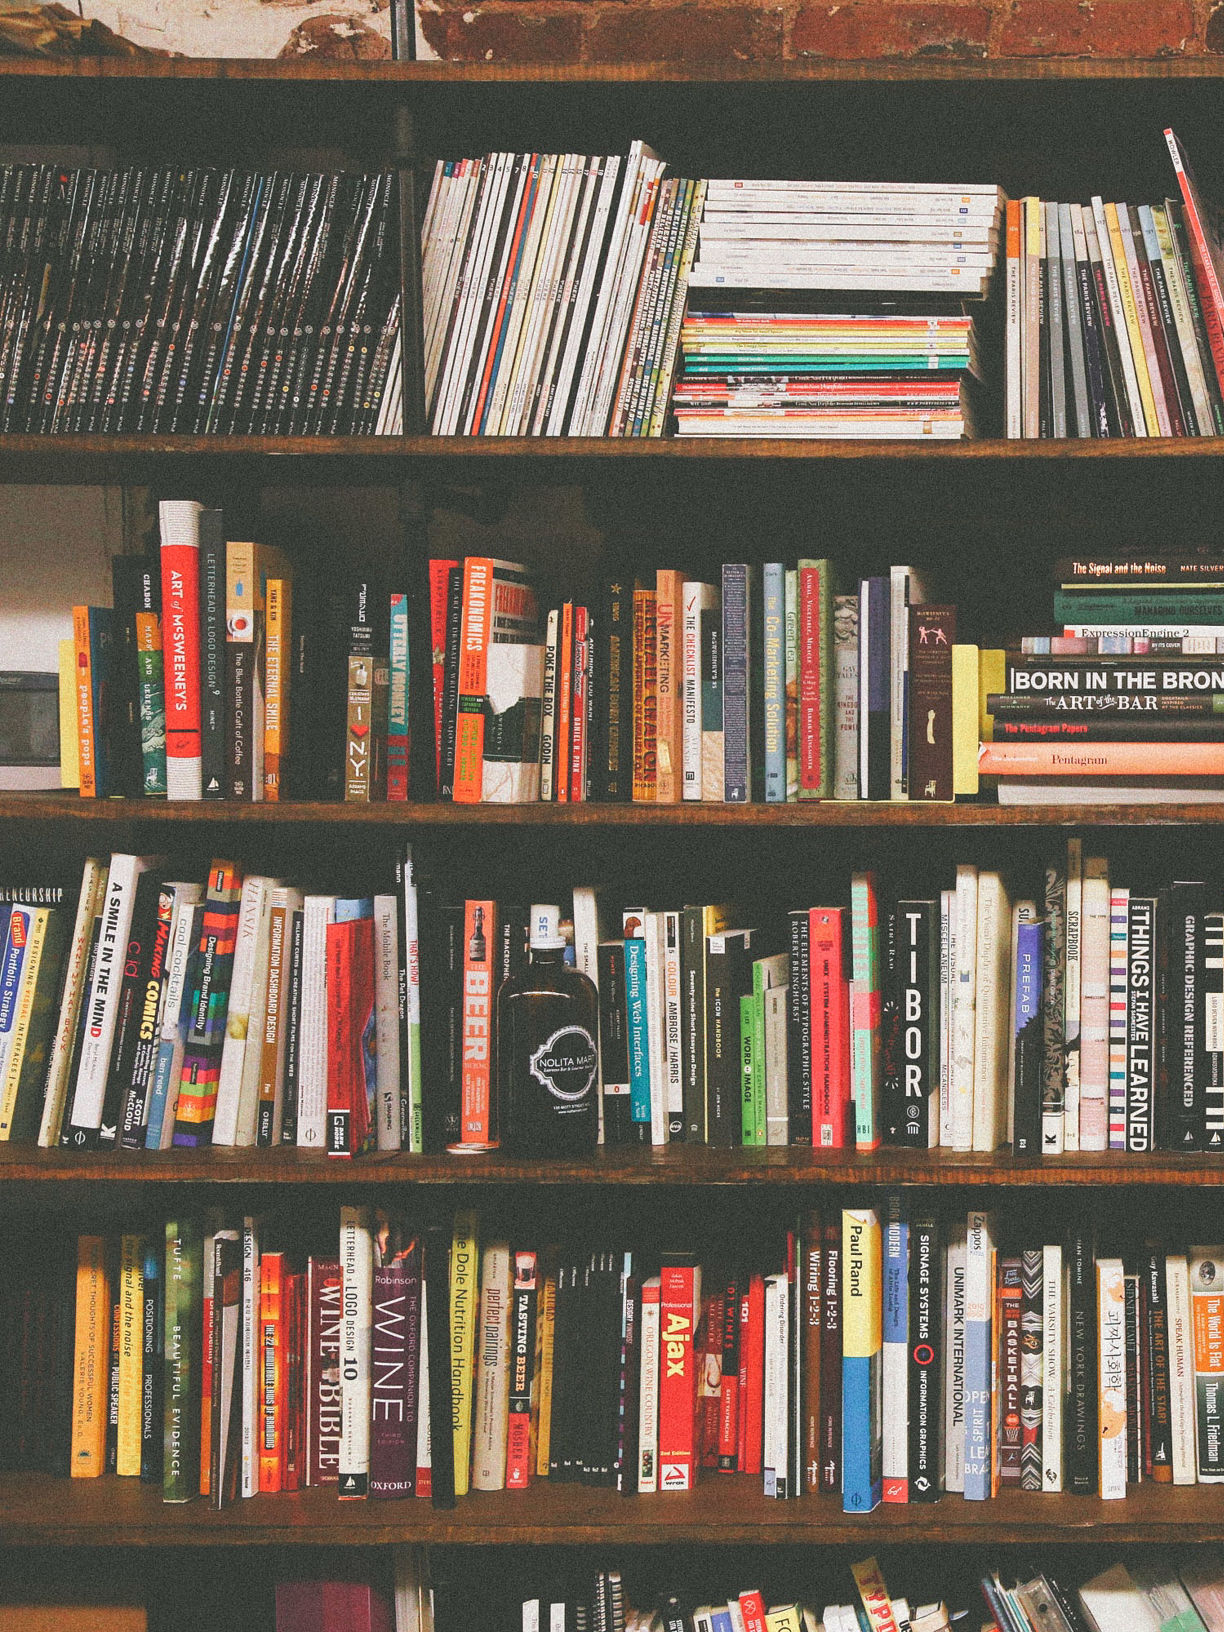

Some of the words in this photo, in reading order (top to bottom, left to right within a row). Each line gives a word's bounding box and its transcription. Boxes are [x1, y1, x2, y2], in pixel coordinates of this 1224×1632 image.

[328, 176, 338, 208] MONOCLE
[383, 174, 392, 207] MONOCLE
[668, 210, 682, 253] BELIEVER
[1158, 283, 1166, 299] PARIS
[1162, 301, 1171, 324] REVIEW
[171, 570, 182, 598] ART
[207, 554, 216, 613] LETTERHEAD
[1073, 563, 1086, 574] The
[1089, 563, 1112, 575] Signal
[1115, 564, 1128, 574] and
[1130, 564, 1142, 573] the
[1144, 564, 1166, 573] Noise
[172, 601, 183, 610] of
[467, 566, 487, 651] FREAKONOMICS
[768, 596, 777, 610] The
[208, 626, 216, 650] LOGO
[686, 616, 695, 630] THE
[1082, 629, 1180, 638] ExpressionEngine
[1183, 629, 1189, 638] 2
[235, 652, 243, 665] The
[267, 635, 279, 653] THE
[393, 614, 406, 669] UTTERLY
[545, 646, 555, 671] POKE
[686, 634, 695, 676] CHECKLIST
[765, 616, 780, 699] Co-Marketing
[208, 653, 216, 687] DESIGN
[235, 668, 243, 683] Blue
[267, 657, 279, 698] ETERNAL
[545, 675, 554, 693] THE
[1015, 672, 1078, 689] BORN
[1085, 672, 1106, 689] IN
[1113, 672, 1156, 689] THE
[80, 685, 91, 734] people's
[235, 686, 243, 707] Bottle
[392, 672, 405, 724] MONKEY
[544, 697, 553, 717] BOX
[686, 680, 695, 723] MANIFESTO
[1044, 697, 1055, 706] The
[1056, 696, 1094, 710] ART
[1117, 695, 1158, 710] BAR
[235, 710, 243, 728] Craft
[266, 703, 278, 730] SMILE
[767, 704, 780, 752] Solution
[1005, 724, 1017, 733] The
[1021, 723, 1059, 734] Pentagram
[1062, 723, 1088, 734] Papers
[82, 739, 92, 766] pops
[234, 740, 243, 765] Coffee
[542, 735, 552, 764] GODIN
[1052, 754, 1107, 765] Pentagram
[113, 883, 122, 892] A
[13, 917, 23, 944] Brand
[105, 897, 120, 942] SMILE
[382, 914, 391, 927] The
[1068, 911, 1078, 961] SCRAPBOOK
[103, 947, 113, 962] IN
[151, 921, 169, 978] MAKING
[203, 937, 216, 974] Designing
[269, 916, 282, 966] INFORMATION
[382, 930, 391, 957] Mobile
[791, 921, 799, 958] ROBERT
[1131, 912, 1149, 987] THINGS
[1185, 915, 1194, 972] GRAPHIC
[6, 948, 20, 988] Portfolio
[97, 968, 110, 994] THE
[383, 960, 391, 980] Book
[629, 946, 640, 997] Designing
[668, 961, 676, 996] COLOUR
[1021, 954, 1031, 1013] PREFAB
[201, 976, 211, 998] Brand
[267, 969, 279, 1014] DASHBOARD
[792, 961, 800, 1022] BRINGHURST
[801, 994, 808, 1007] OF
[1184, 975, 1194, 1021] DESIGN
[0, 990, 15, 1029] Strategy
[90, 999, 106, 1038] MIND
[140, 981, 160, 1040] COMICS
[196, 1000, 209, 1030] Identity
[465, 971, 488, 1060] BEER
[632, 1000, 641, 1023] Web
[668, 1002, 677, 1043] AMBROSE
[905, 913, 921, 1097] TIBOR
[1137, 1002, 1148, 1041] HAVE
[266, 1016, 277, 1043] DESIGN
[801, 1009, 809, 1079] TYPOGRAPHIC
[539, 1057, 574, 1067] NOLITA
[634, 1026, 643, 1077] Interfaces
[670, 1051, 679, 1084] HARRIS
[1184, 1025, 1193, 1107] REFERENCED
[689, 1064, 697, 1085] Design
[802, 1081, 810, 1110] STYLE
[1130, 1045, 1149, 1151] LEARNED
[850, 1225, 862, 1256] Paul
[973, 1215, 985, 1250] Zappos
[173, 1239, 181, 1280] TUFTE
[456, 1253, 468, 1284] Dole
[809, 1251, 819, 1291] Wiring
[827, 1251, 838, 1295] Flooring
[920, 1235, 929, 1283] SIGNAGE
[376, 1276, 416, 1284] Robinson
[850, 1260, 862, 1297] Rand
[954, 1267, 964, 1325] UNIMARK
[345, 1286, 357, 1316] LOGO
[809, 1295, 819, 1325] 1-2-3
[827, 1301, 837, 1329] 1-2-3
[920, 1288, 928, 1339] SYSTEMS
[1208, 1299, 1218, 1313] The
[145, 1299, 153, 1352] POSITIONING
[346, 1320, 354, 1351] DESIGN
[454, 1289, 467, 1353] Nutrition
[518, 1295, 528, 1353] TASTING
[1209, 1316, 1220, 1339] World
[373, 1296, 406, 1421] WINE
[662, 1313, 690, 1377] Ajax
[1103, 1311, 1121, 1391] 괴짜사회학
[1210, 1351, 1221, 1367] Flat
[344, 1358, 357, 1380] 10
[516, 1356, 527, 1391] BEER
[953, 1329, 964, 1426] INTERNATIONAL
[1008, 1321, 1017, 1409] BASKETBALL
[144, 1374, 152, 1439] PROFESSIONALS
[452, 1358, 465, 1432] Handbook
[1206, 1383, 1218, 1414] Thomas
[172, 1408, 180, 1476] EVIDENCE
[919, 1428, 927, 1469] GRAPHICS
[1208, 1425, 1220, 1461] Friedman
